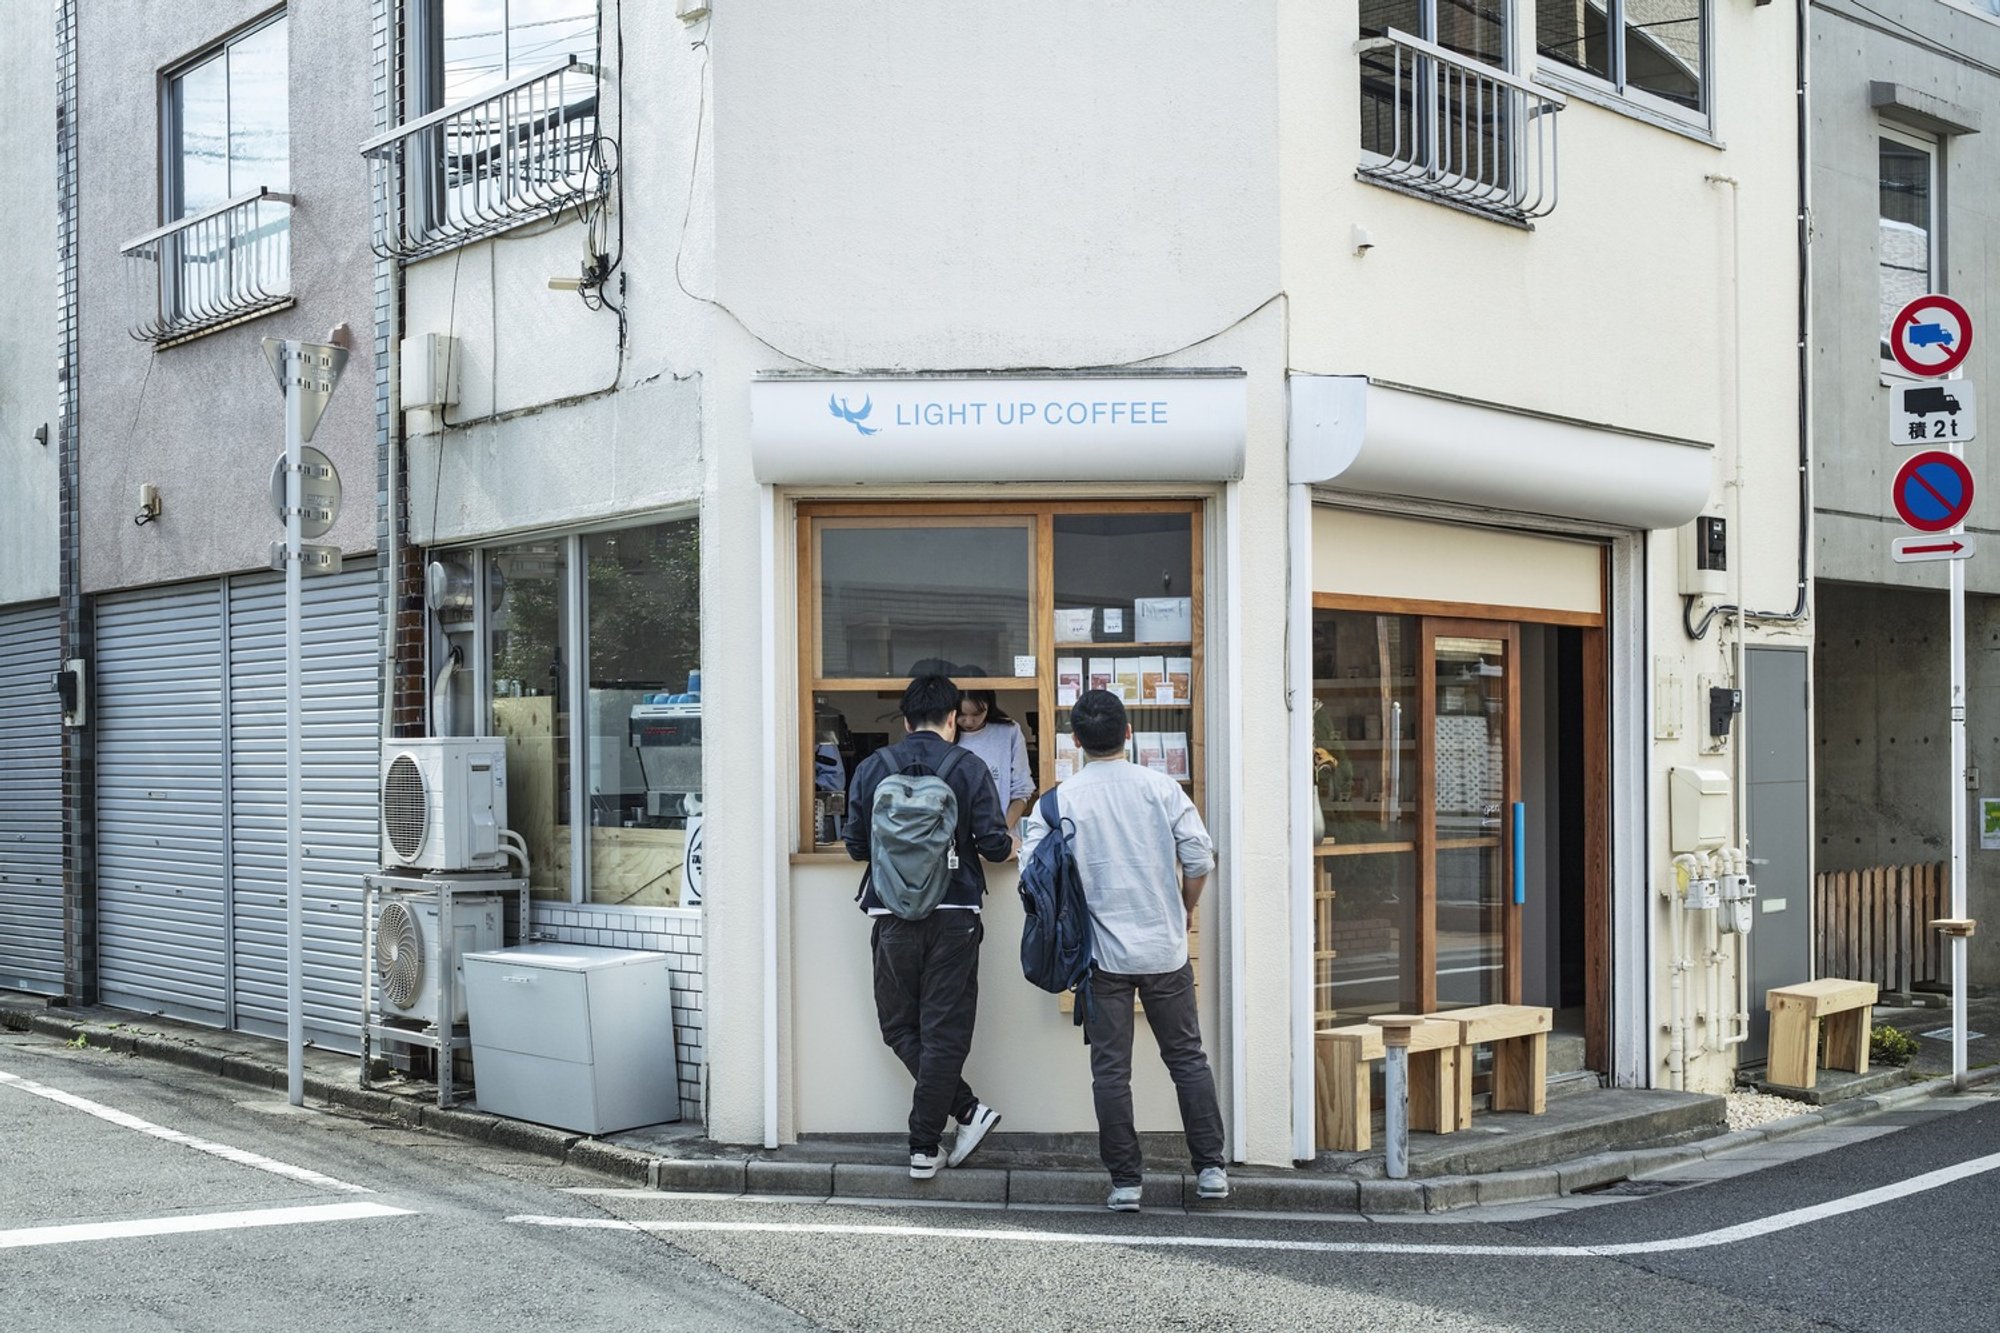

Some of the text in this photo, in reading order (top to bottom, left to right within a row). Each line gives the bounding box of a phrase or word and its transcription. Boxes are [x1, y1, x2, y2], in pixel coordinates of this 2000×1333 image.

[897, 402, 1168, 425] LIGHT UP COFFEE
